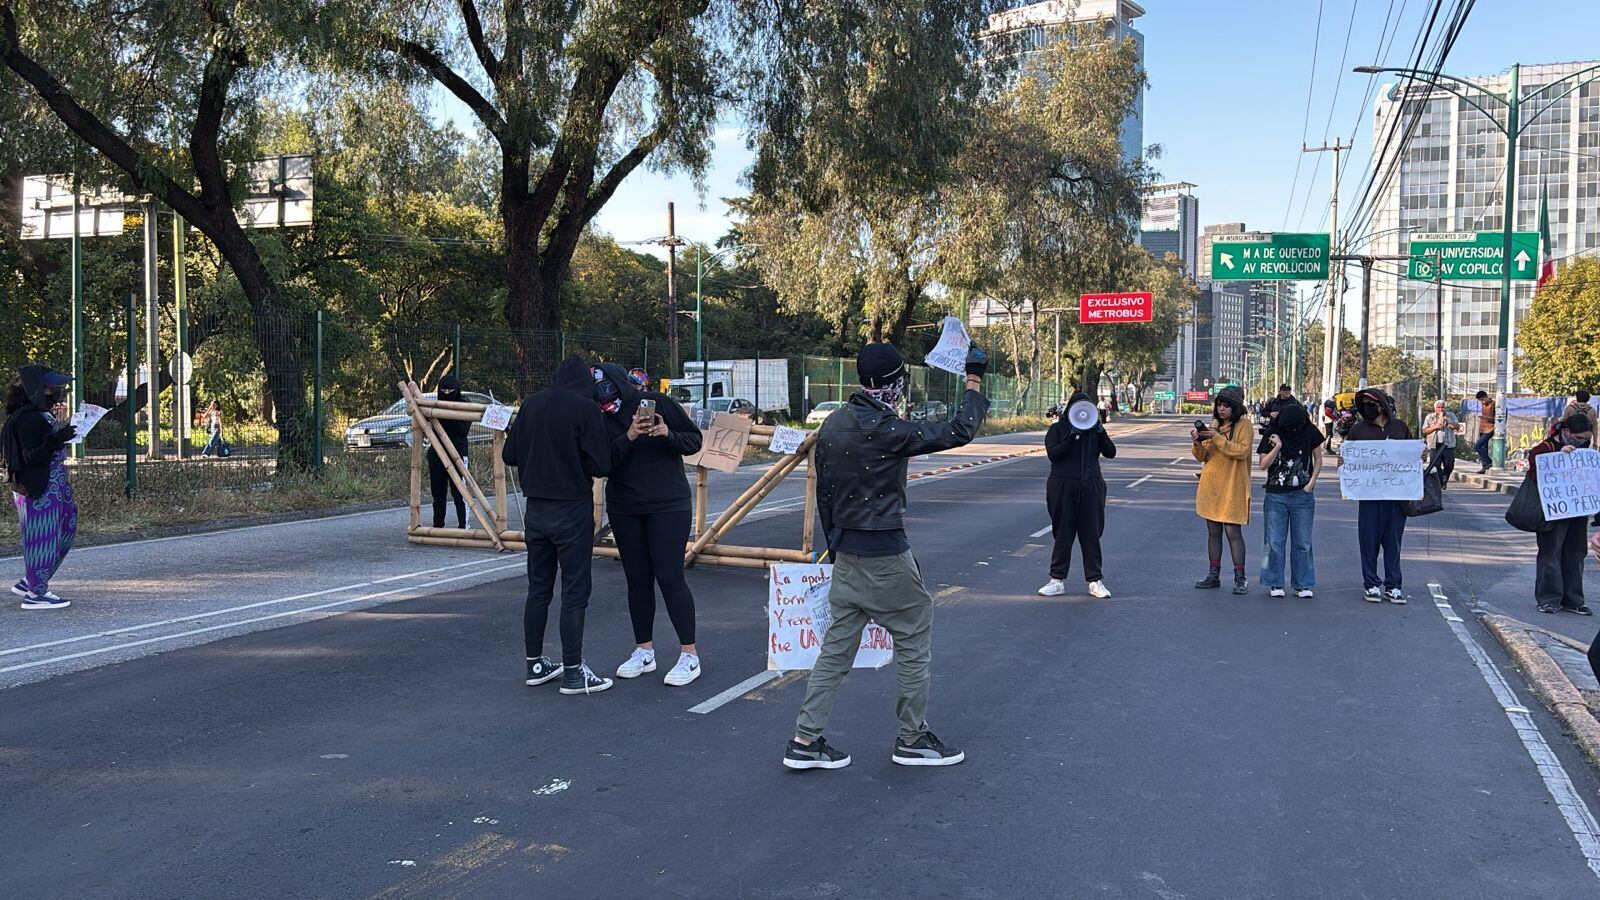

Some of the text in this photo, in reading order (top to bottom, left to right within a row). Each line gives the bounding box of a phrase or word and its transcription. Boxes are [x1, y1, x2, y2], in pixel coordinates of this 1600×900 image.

[1243, 247, 1321, 259] M A DE QUEVEDO
[1423, 247, 1437, 258] AV
[1242, 262, 1321, 274] AV REVOLUCION
[1441, 263, 1454, 274] AV
[1088, 297, 1144, 307] EXCLUSIVO
[1088, 310, 1144, 319] METROBUS
[712, 427, 744, 455] FCA
[1346, 447, 1389, 459] FUERA
[1539, 456, 1550, 470] SI
[1553, 454, 1566, 468] LA
[1343, 478, 1360, 487] DE
[1366, 477, 1377, 487] LA
[1544, 472, 1558, 484] ES
[1543, 486, 1563, 500] QUE
[1566, 484, 1578, 497] LA
[1547, 501, 1568, 517] NO
[773, 567, 791, 586] La
